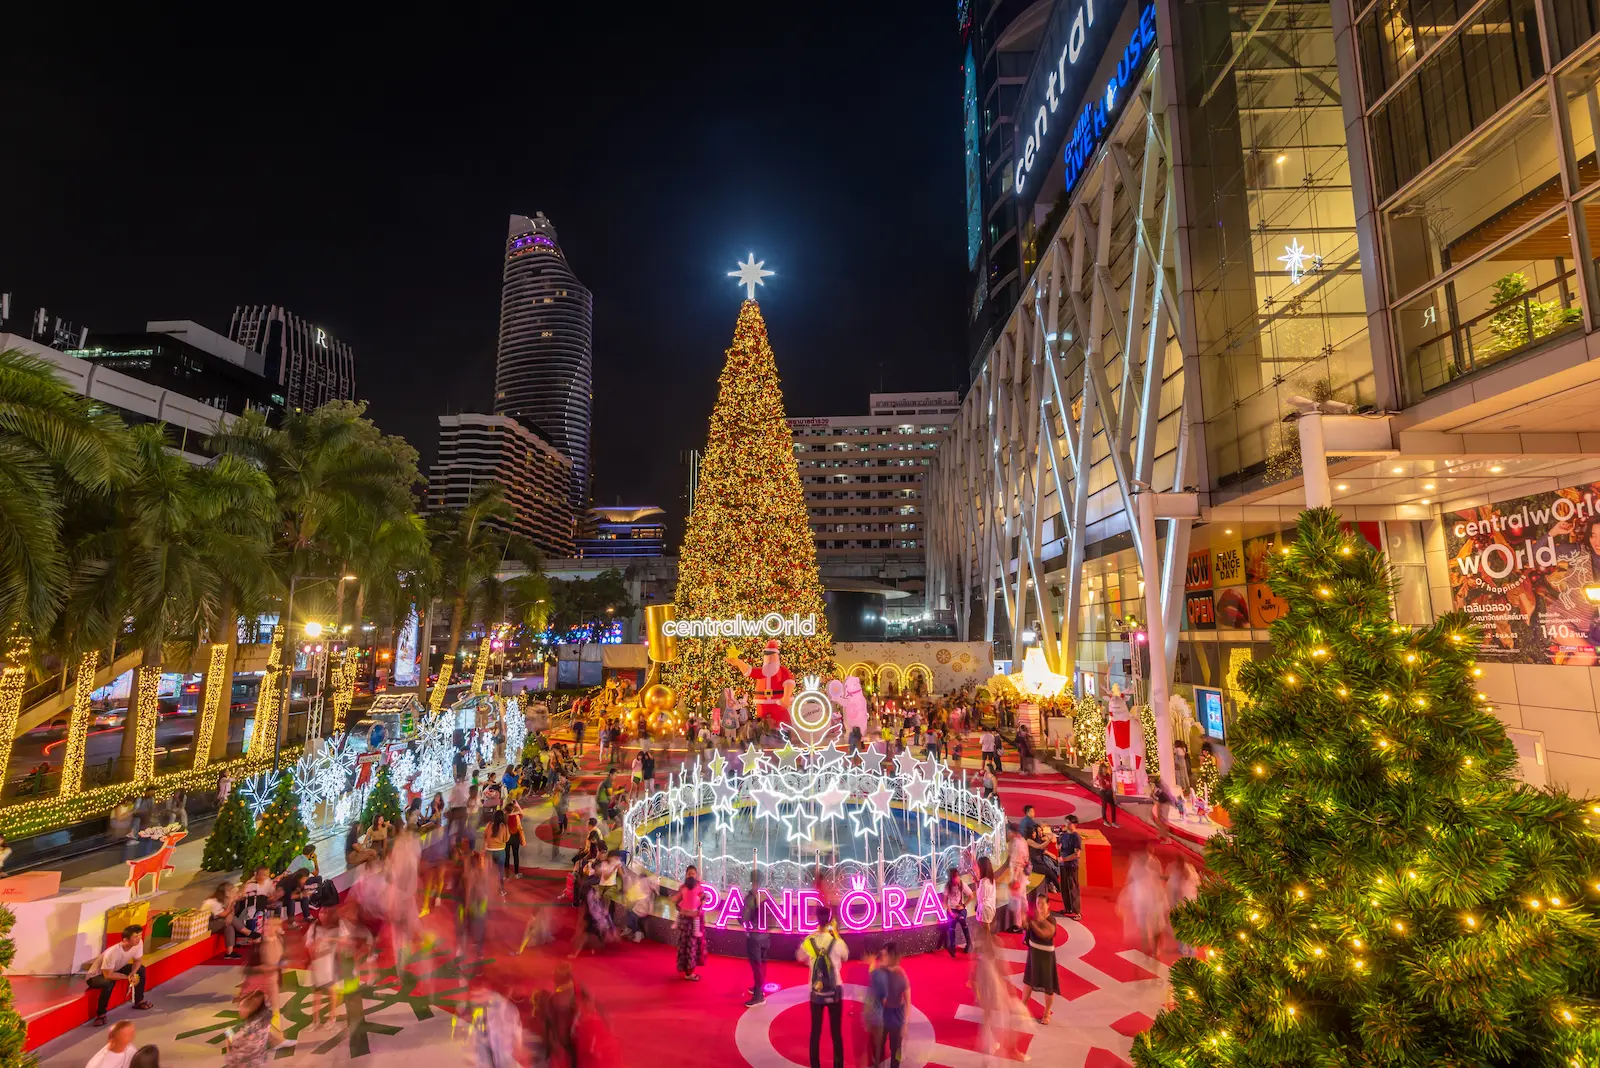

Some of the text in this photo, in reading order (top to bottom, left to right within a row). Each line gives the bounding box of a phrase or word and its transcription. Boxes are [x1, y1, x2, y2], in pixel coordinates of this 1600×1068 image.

[1065, 125, 1093, 193] LIVE
[316, 327, 329, 349] R
[1215, 559, 1240, 572] A NICE
[1217, 550, 1237, 562] HAVE
[1457, 536, 1557, 579] wOrld
[1220, 569, 1239, 580] DAY!
[1475, 574, 1527, 595] Of happiness
[1187, 596, 1215, 624] OPEN
[1261, 603, 1276, 611] HAPPY
[1463, 602, 1512, 613] เฉลิมฉลอง
[662, 612, 816, 637] centralwOrld
[1540, 624, 1569, 639] 140
[700, 882, 948, 932] PANDORA
